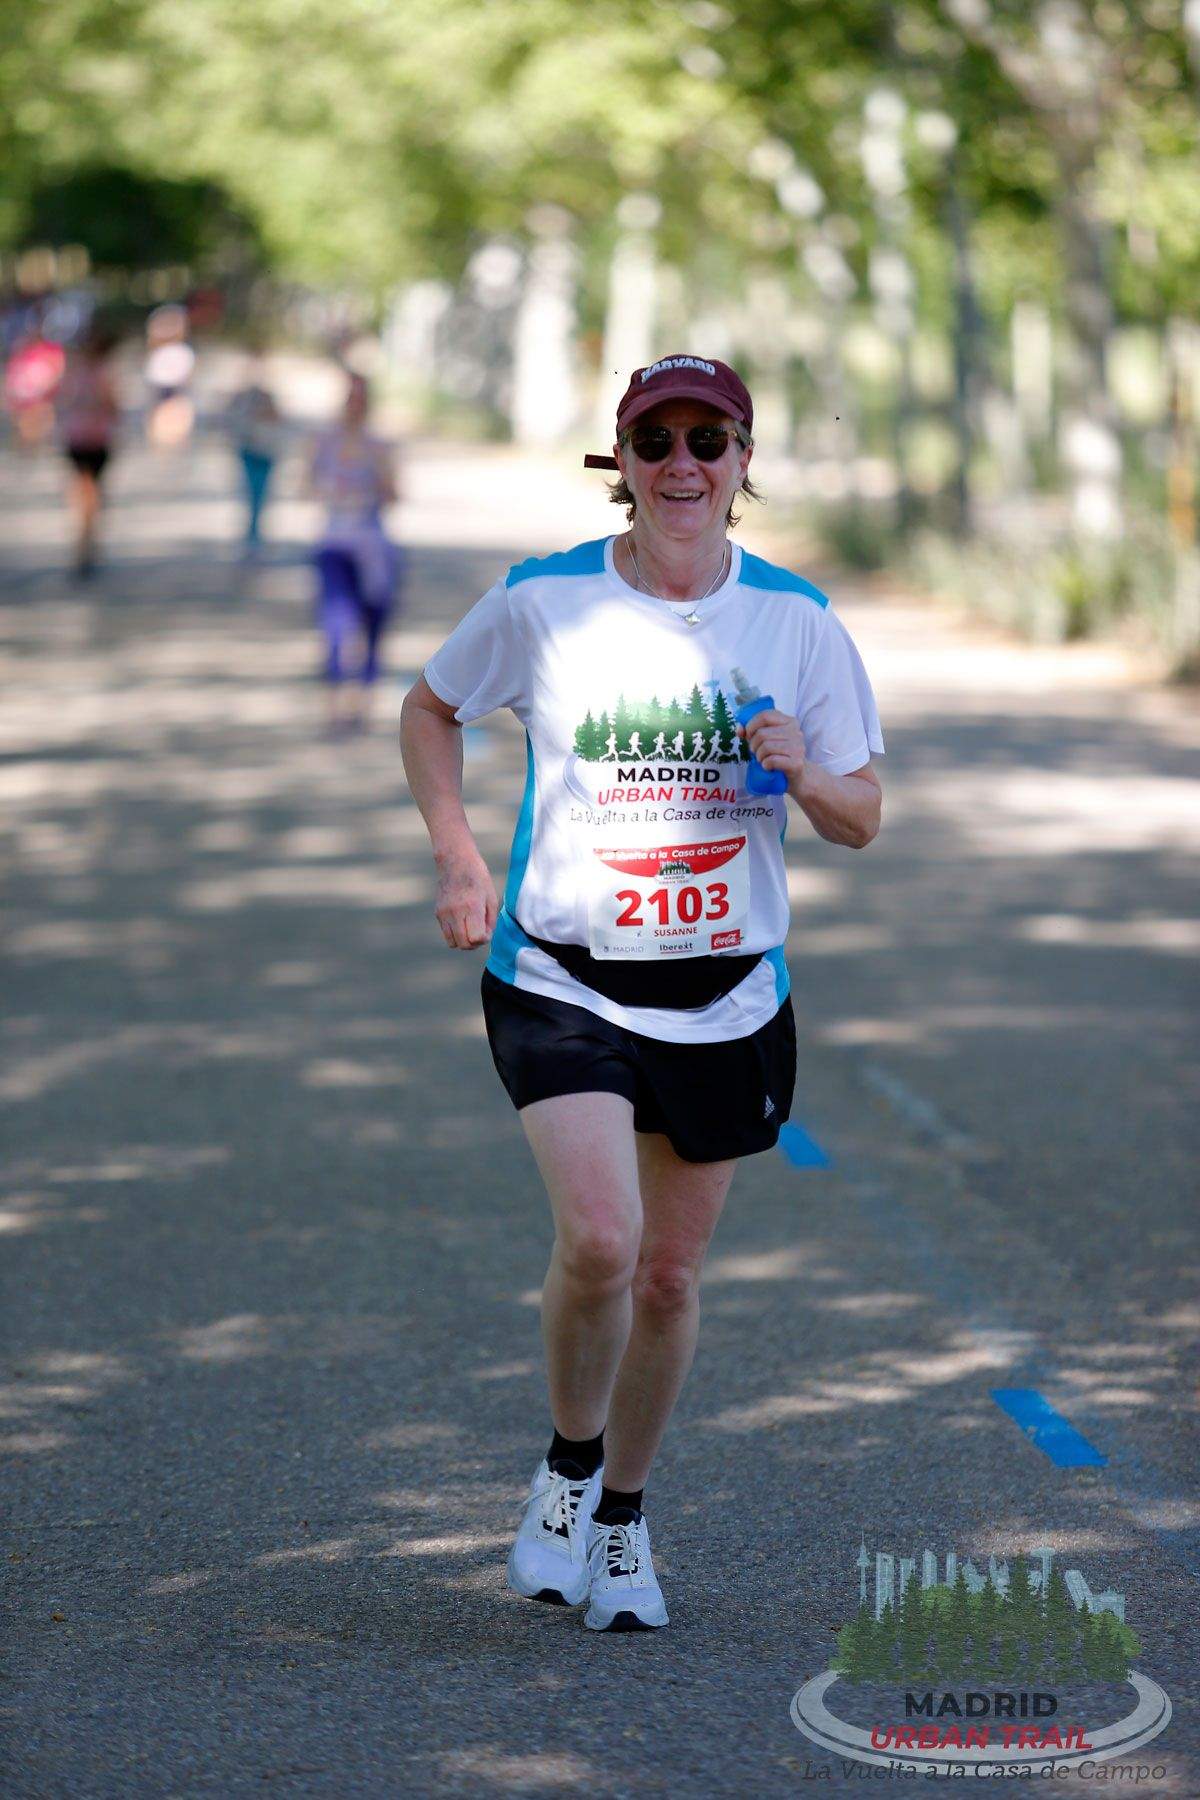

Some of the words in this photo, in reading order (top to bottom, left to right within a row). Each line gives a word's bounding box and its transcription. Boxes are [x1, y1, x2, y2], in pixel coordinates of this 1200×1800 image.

[617, 768, 720, 783] MADRID
[599, 787, 673, 805] URBAN
[585, 810, 626, 825] Vuelta
[630, 811, 639, 822] a
[645, 809, 658, 822] la
[663, 808, 701, 821] Casa
[706, 807, 726, 820] de
[671, 847, 695, 858] Casa
[697, 846, 709, 856] de
[711, 843, 740, 855] Campo
[615, 883, 730, 927] 2103
[654, 927, 698, 937] SUSANNE
